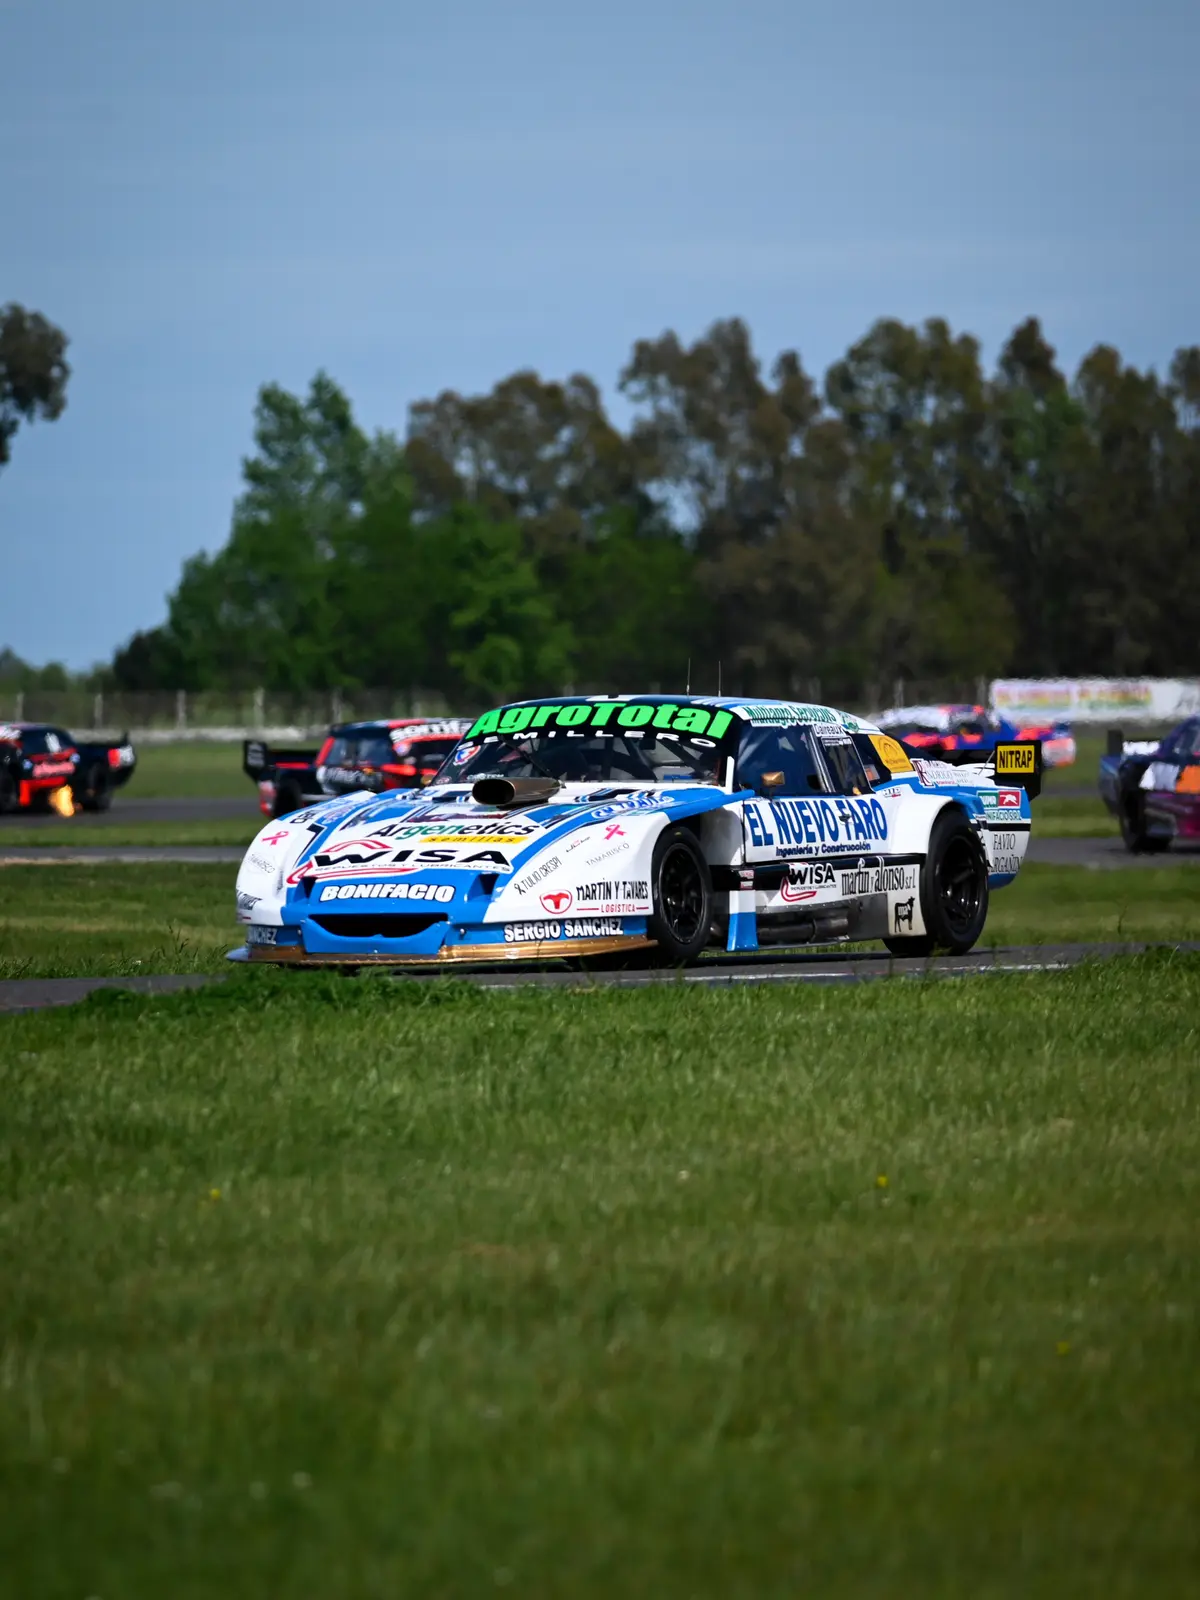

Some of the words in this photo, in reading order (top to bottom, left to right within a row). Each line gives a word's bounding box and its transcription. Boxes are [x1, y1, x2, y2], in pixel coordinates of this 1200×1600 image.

[466, 702, 733, 739] AgroTotal
[457, 730, 717, 751] SEMILLERO
[998, 750, 1033, 769] NITRAP
[365, 821, 540, 841] Argenetics
[743, 803, 774, 847] EL
[768, 799, 840, 845] NUEVO
[833, 798, 888, 841] FARO
[775, 844, 813, 858] Ingeniería
[814, 846, 821, 857] y
[821, 842, 872, 854] Construcción
[993, 833, 1016, 850] FAVIO
[314, 850, 511, 868] WISA
[586, 842, 630, 866] TAMARISCO
[520, 873, 542, 891] TULIO
[540, 856, 563, 878] CRESPI
[789, 864, 836, 886] WISA
[320, 883, 455, 902] BONIFACIO
[615, 880, 621, 900] Y
[601, 904, 635, 913] LOGISTICA
[504, 920, 560, 942] SERGIO
[564, 918, 624, 938] SANCHEZ
